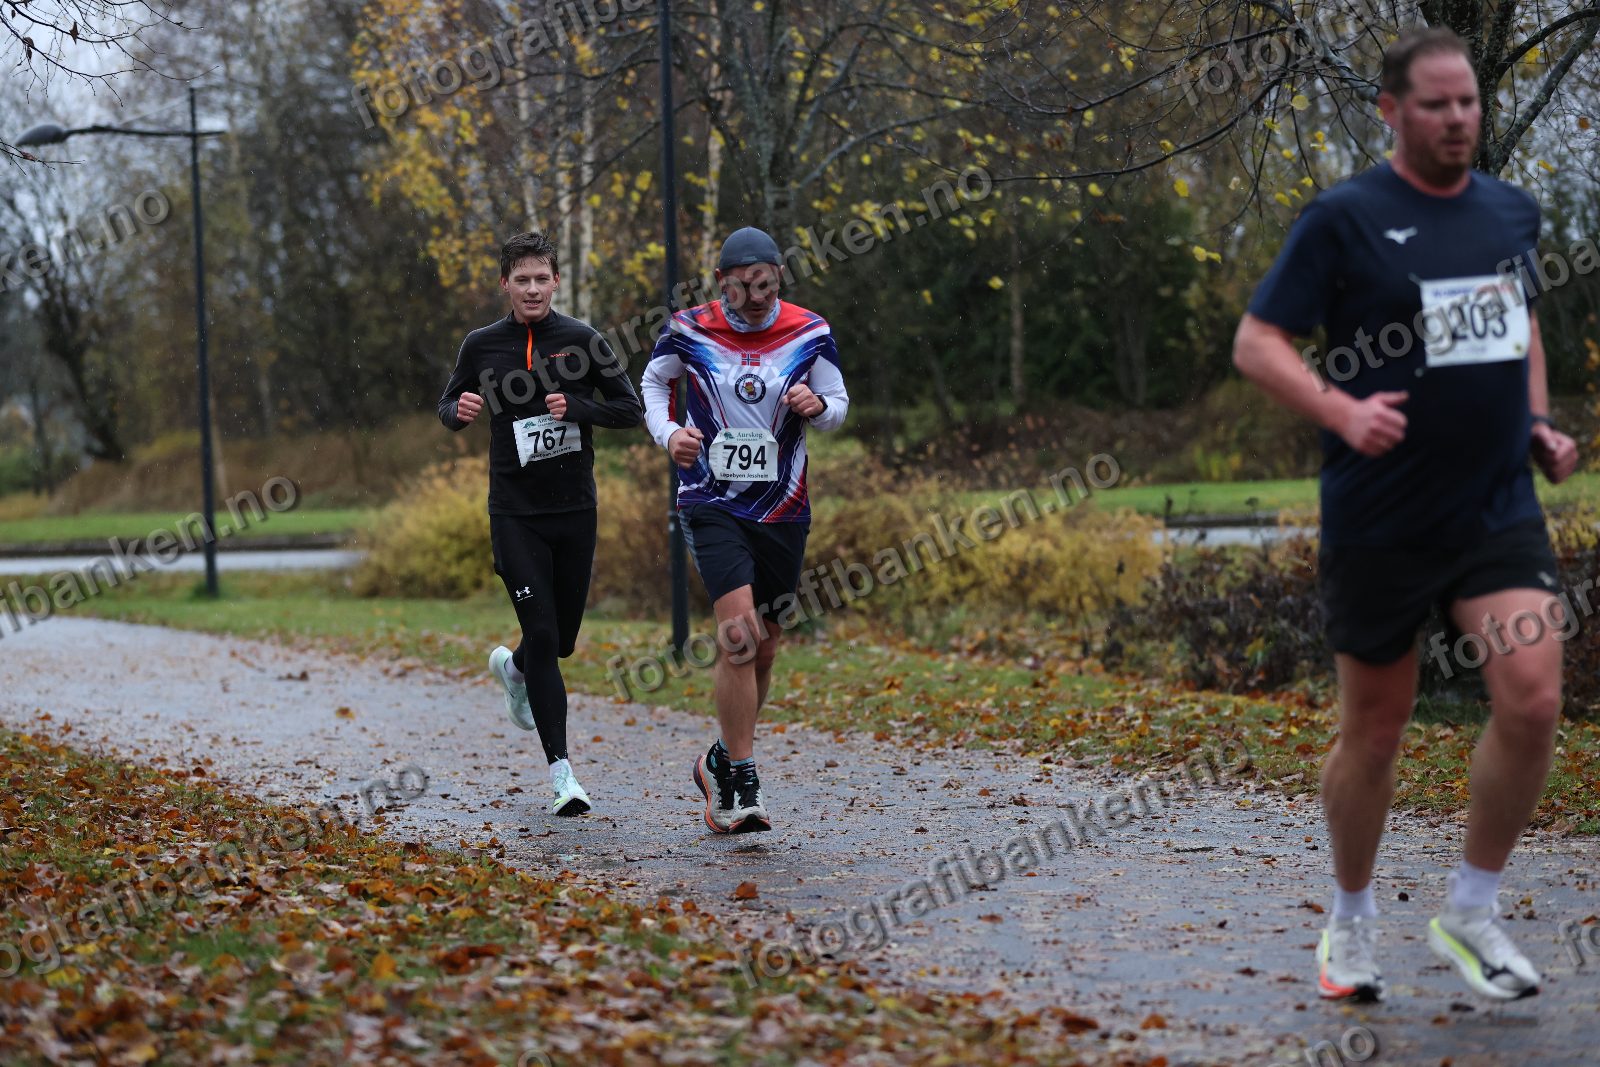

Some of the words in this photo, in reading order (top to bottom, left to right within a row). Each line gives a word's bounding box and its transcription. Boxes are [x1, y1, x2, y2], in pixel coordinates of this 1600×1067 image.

[1448, 303, 1506, 338] 203
[527, 425, 567, 454] 767
[723, 444, 767, 470] 794
